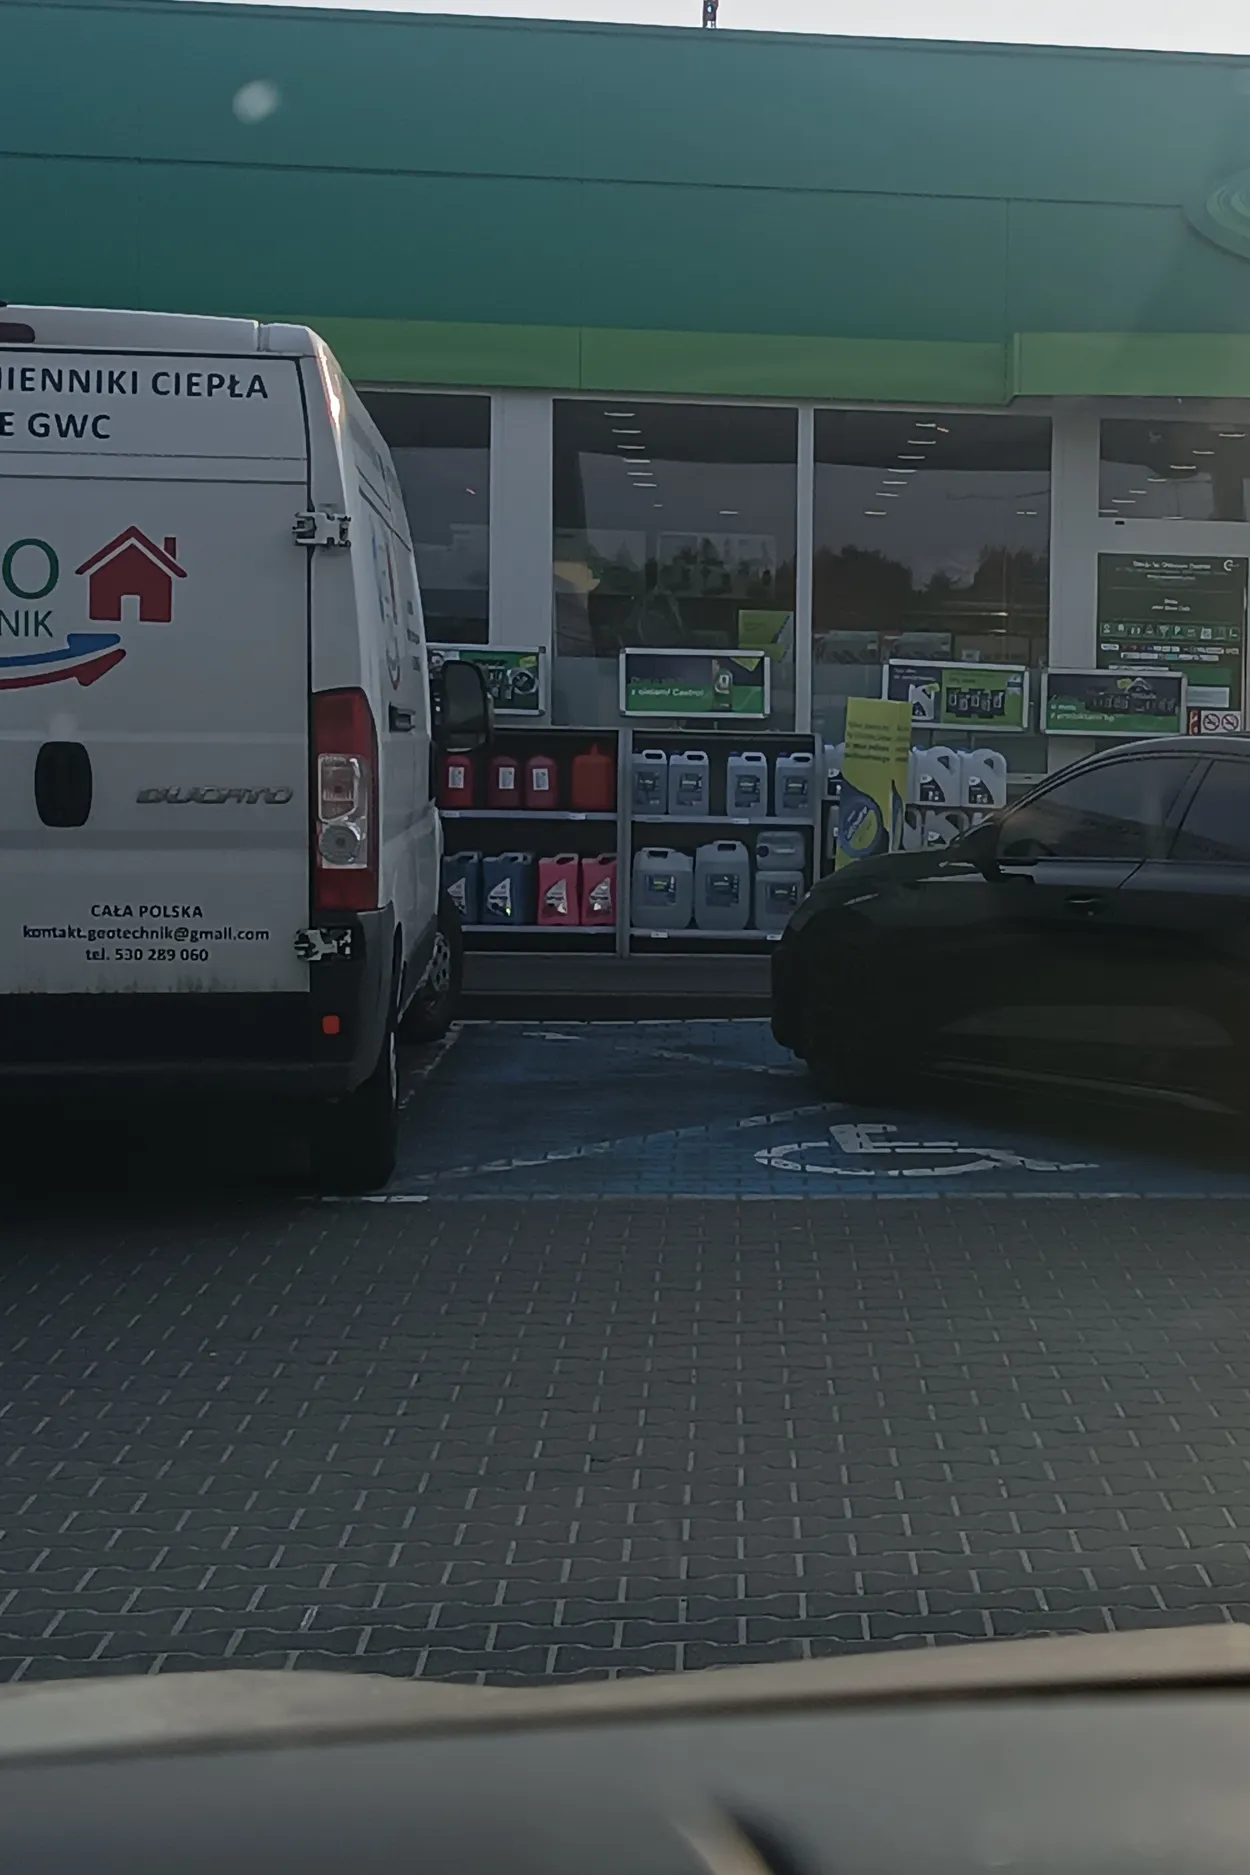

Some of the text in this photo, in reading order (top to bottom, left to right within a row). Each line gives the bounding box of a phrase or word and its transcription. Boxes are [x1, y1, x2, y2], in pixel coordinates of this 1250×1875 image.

[0, 367, 268, 399] IENNIKI CIEPŁA
[27, 413, 111, 439] GWC
[2, 538, 59, 600] O
[0, 610, 53, 638] NIK
[136, 785, 293, 805] DUCATO
[91, 905, 203, 919] CAŁA POLSKA
[85, 948, 209, 962] tel. 530 289 060
